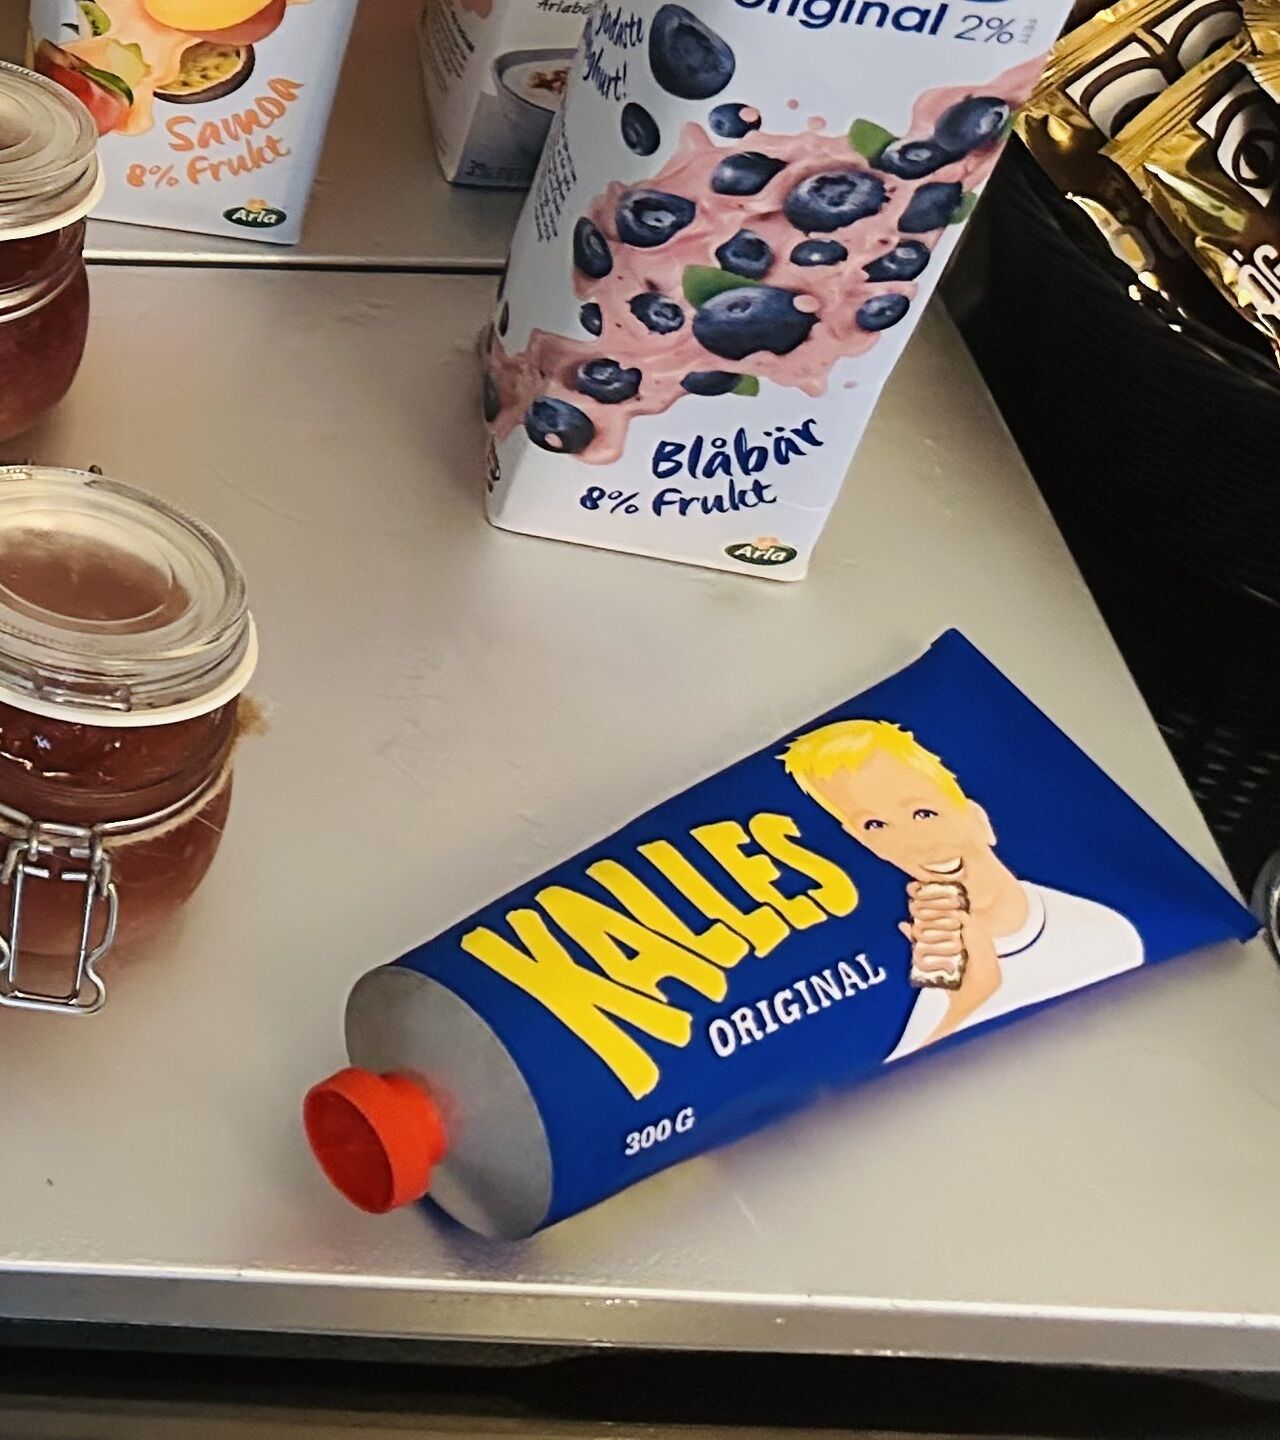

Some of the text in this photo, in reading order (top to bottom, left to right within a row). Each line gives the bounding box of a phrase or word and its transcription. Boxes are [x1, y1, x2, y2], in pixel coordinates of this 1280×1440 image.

[954, 14, 1015, 44] 2%
[164, 76, 305, 152] Samoa
[126, 163, 179, 189] 8%
[231, 205, 279, 225] Arla
[651, 418, 826, 481] Blåbär
[579, 485, 640, 516] 8%
[733, 542, 788, 563] Arla
[460, 812, 859, 1101] KALLES
[708, 952, 888, 1058] ORIGINAL
[624, 1106, 697, 1156] 300 G
